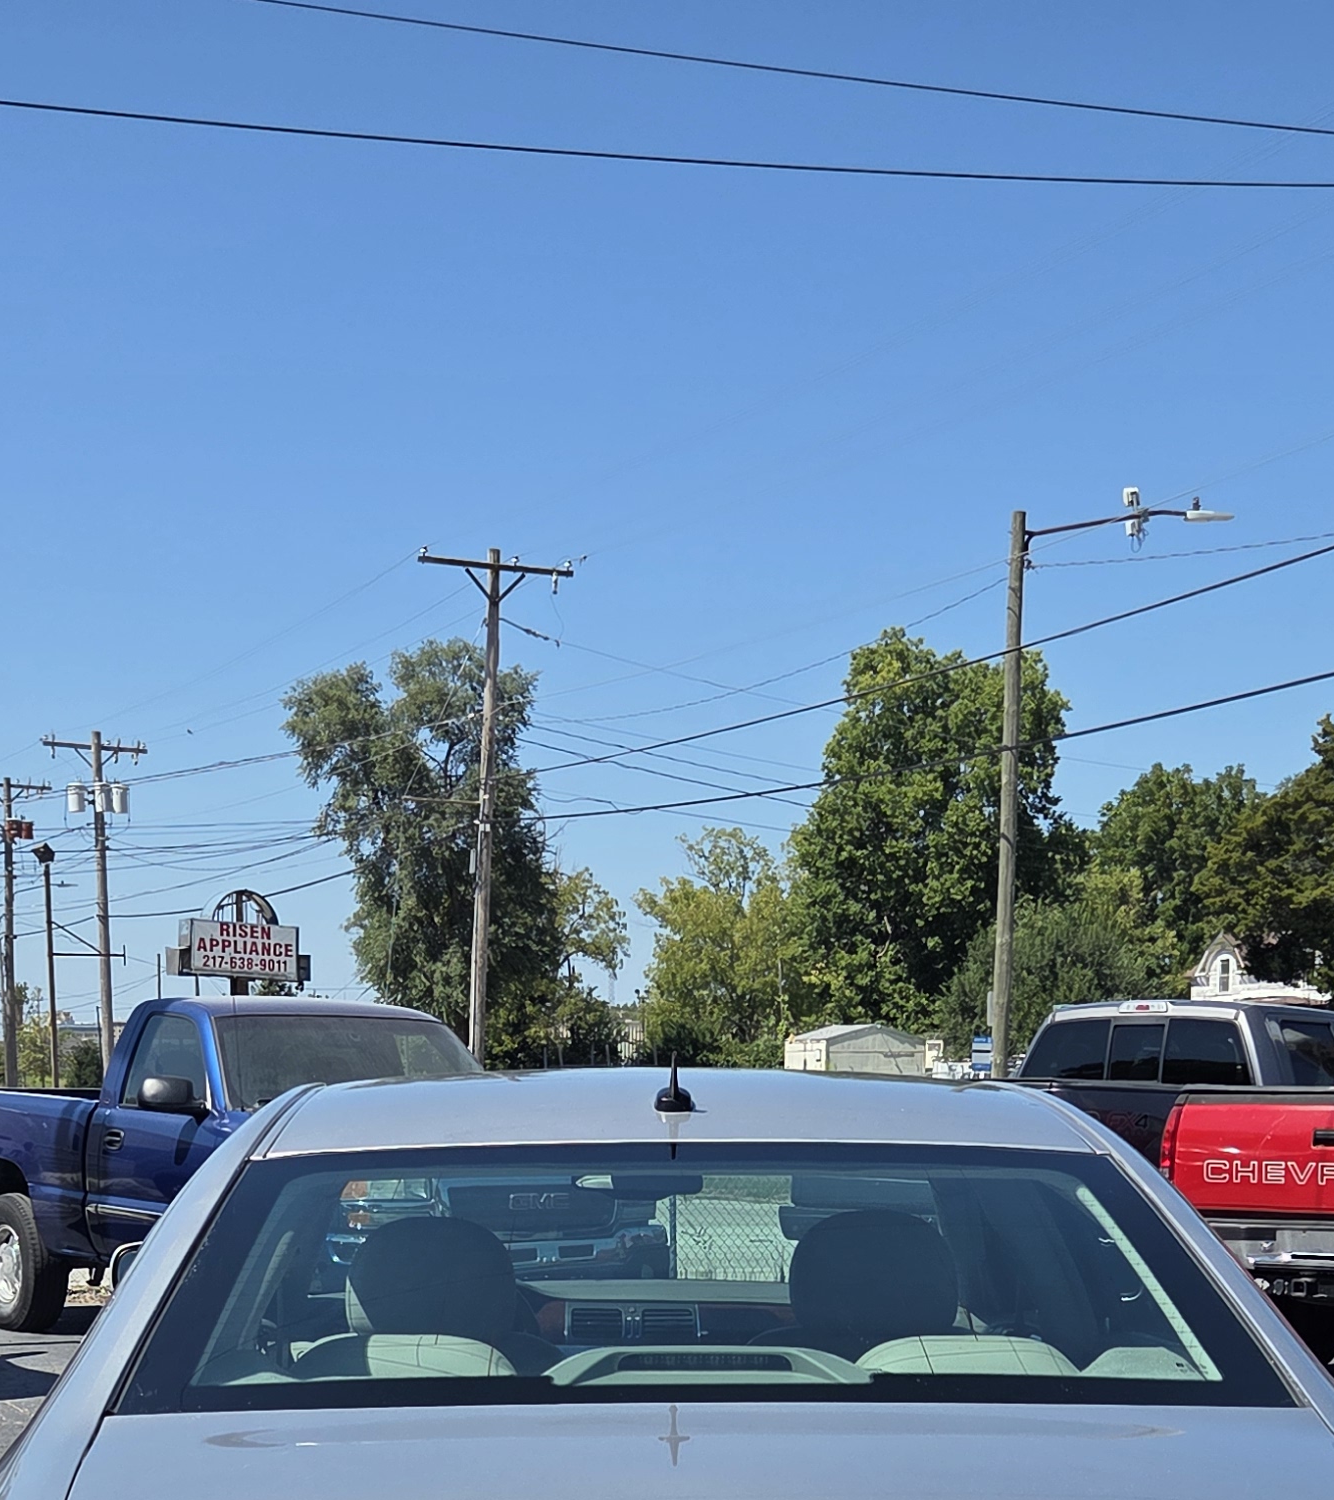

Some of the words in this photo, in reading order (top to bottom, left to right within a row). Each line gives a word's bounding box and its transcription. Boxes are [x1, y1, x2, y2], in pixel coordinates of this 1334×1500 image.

[219, 922, 272, 941] RISEN
[197, 937, 294, 958] APPLIANCE
[202, 954, 288, 973] 217-638-9011
